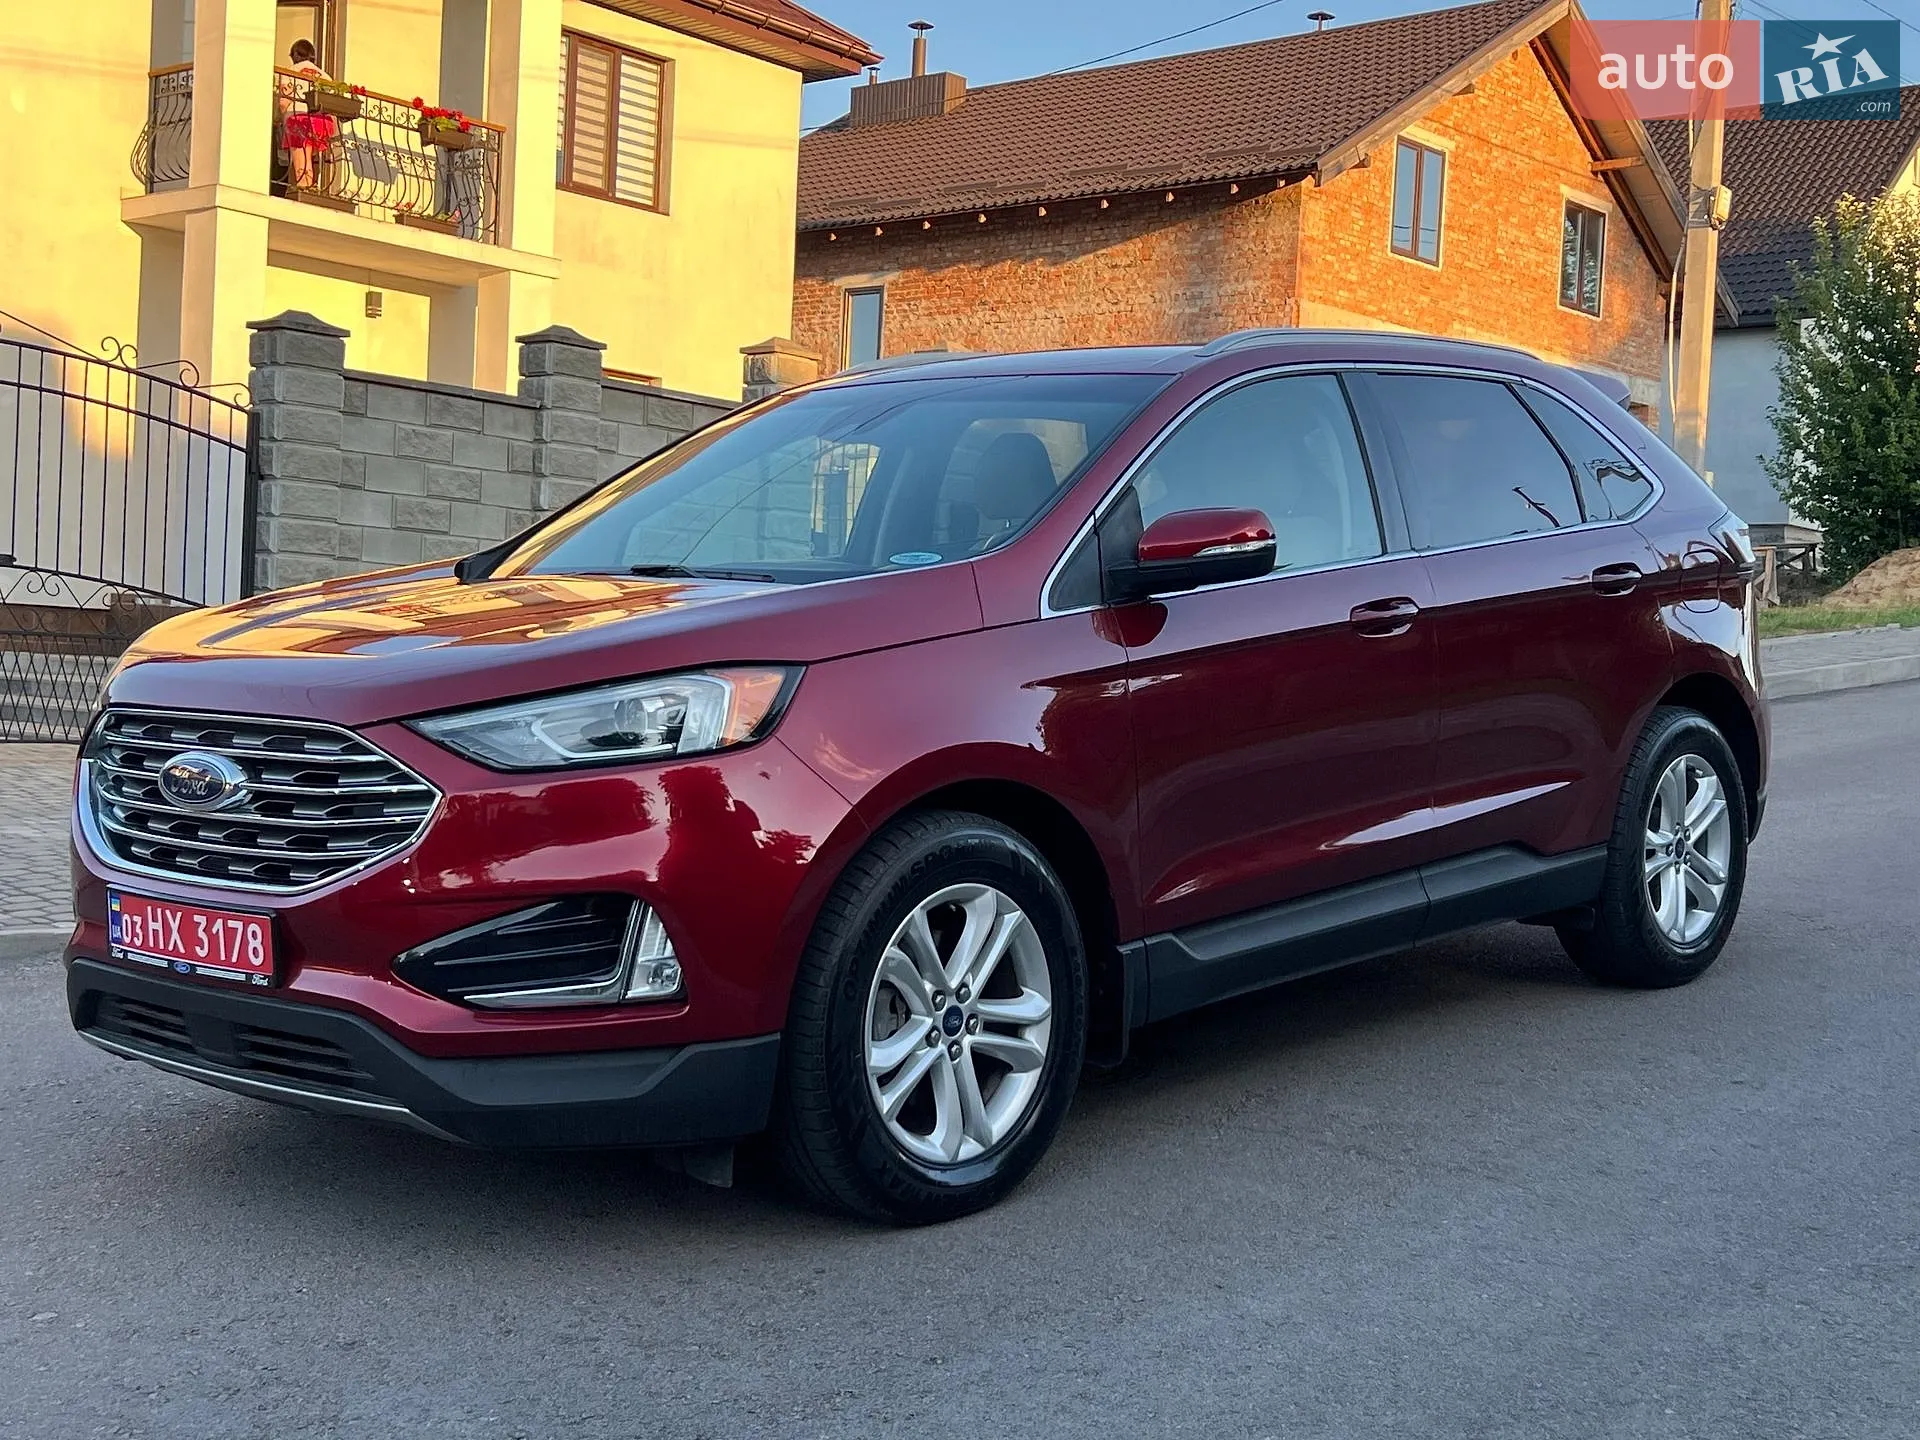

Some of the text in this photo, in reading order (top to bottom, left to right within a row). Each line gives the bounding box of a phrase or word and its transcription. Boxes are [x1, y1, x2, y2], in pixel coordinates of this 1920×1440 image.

[122, 905, 265, 967] 03 HX 3178
[252, 974, 269, 986] Ford
